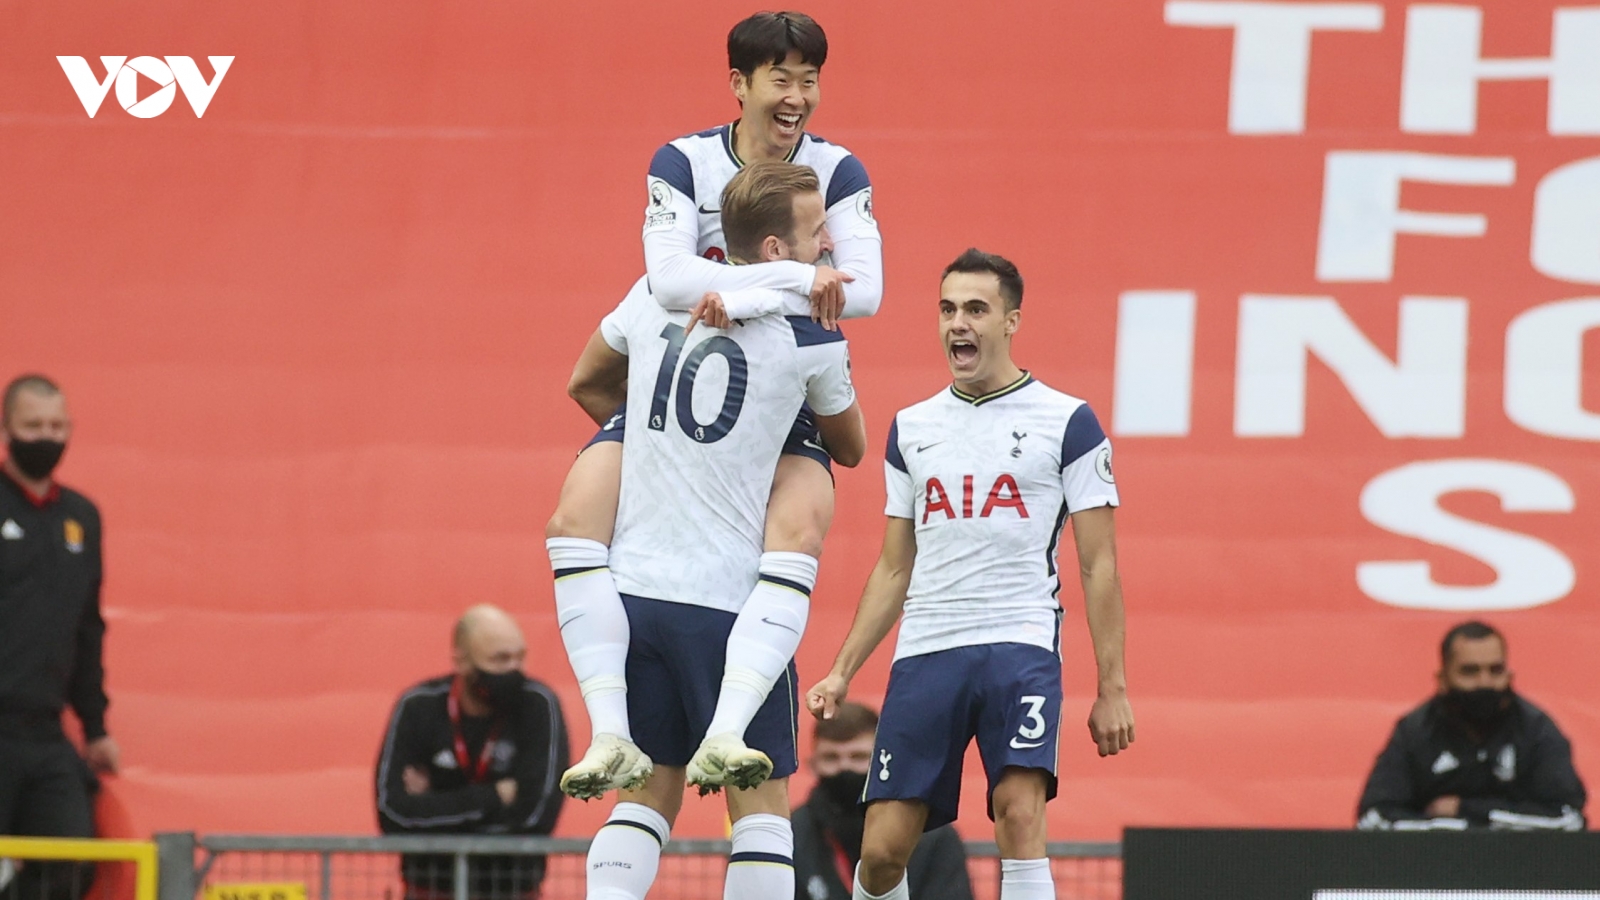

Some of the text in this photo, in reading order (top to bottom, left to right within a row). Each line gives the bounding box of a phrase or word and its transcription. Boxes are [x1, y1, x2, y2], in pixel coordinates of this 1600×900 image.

[648, 321, 748, 444] 10
[921, 473, 1030, 525] AIA
[1355, 457, 1577, 612] S
[1018, 695, 1047, 740] 3
[592, 860, 633, 871] SPURS
